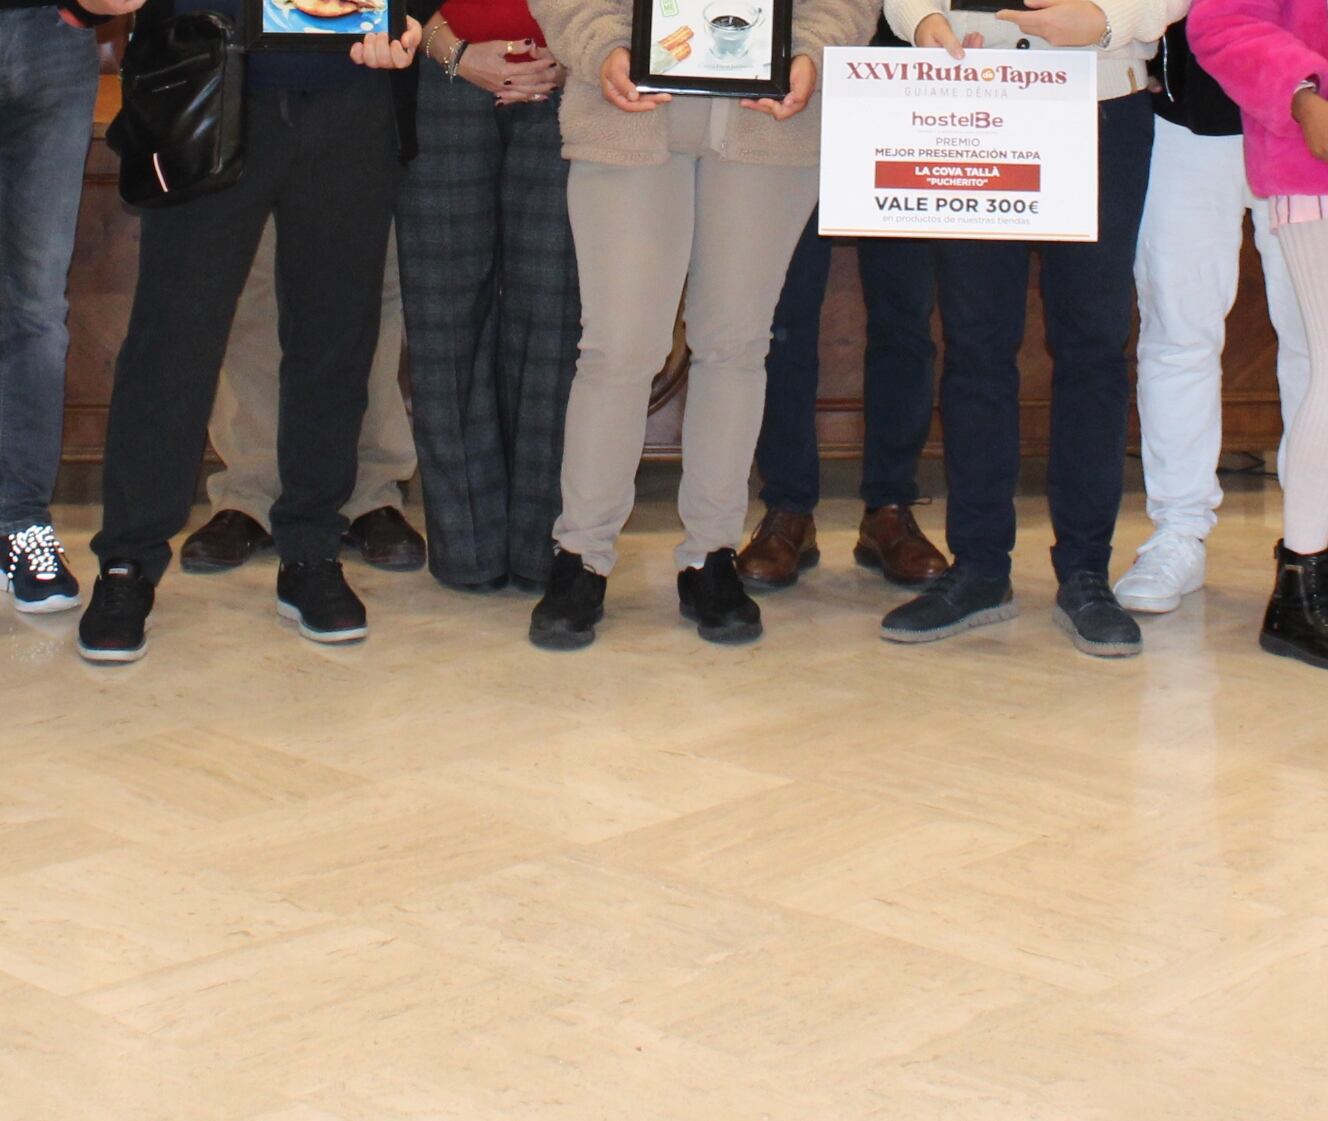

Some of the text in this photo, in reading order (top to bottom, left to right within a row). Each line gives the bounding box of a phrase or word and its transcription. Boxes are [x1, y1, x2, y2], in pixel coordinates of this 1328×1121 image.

[846, 61, 908, 81] XXVI
[913, 62, 979, 82] Ruta
[995, 65, 1068, 89] Tapas
[912, 111, 1004, 129] hostelBe
[936, 137, 981, 147] PREMIO
[875, 148, 1040, 160] MEJOR PRESENTACIÓN TAPA
[915, 166, 931, 176] LA
[932, 166, 964, 177] COVA
[875, 197, 1039, 215] VALE POR 300€
[896, 214, 942, 225] productos
[944, 215, 955, 224] de
[957, 216, 995, 225] nuestras
[997, 215, 1031, 226] tiendas
